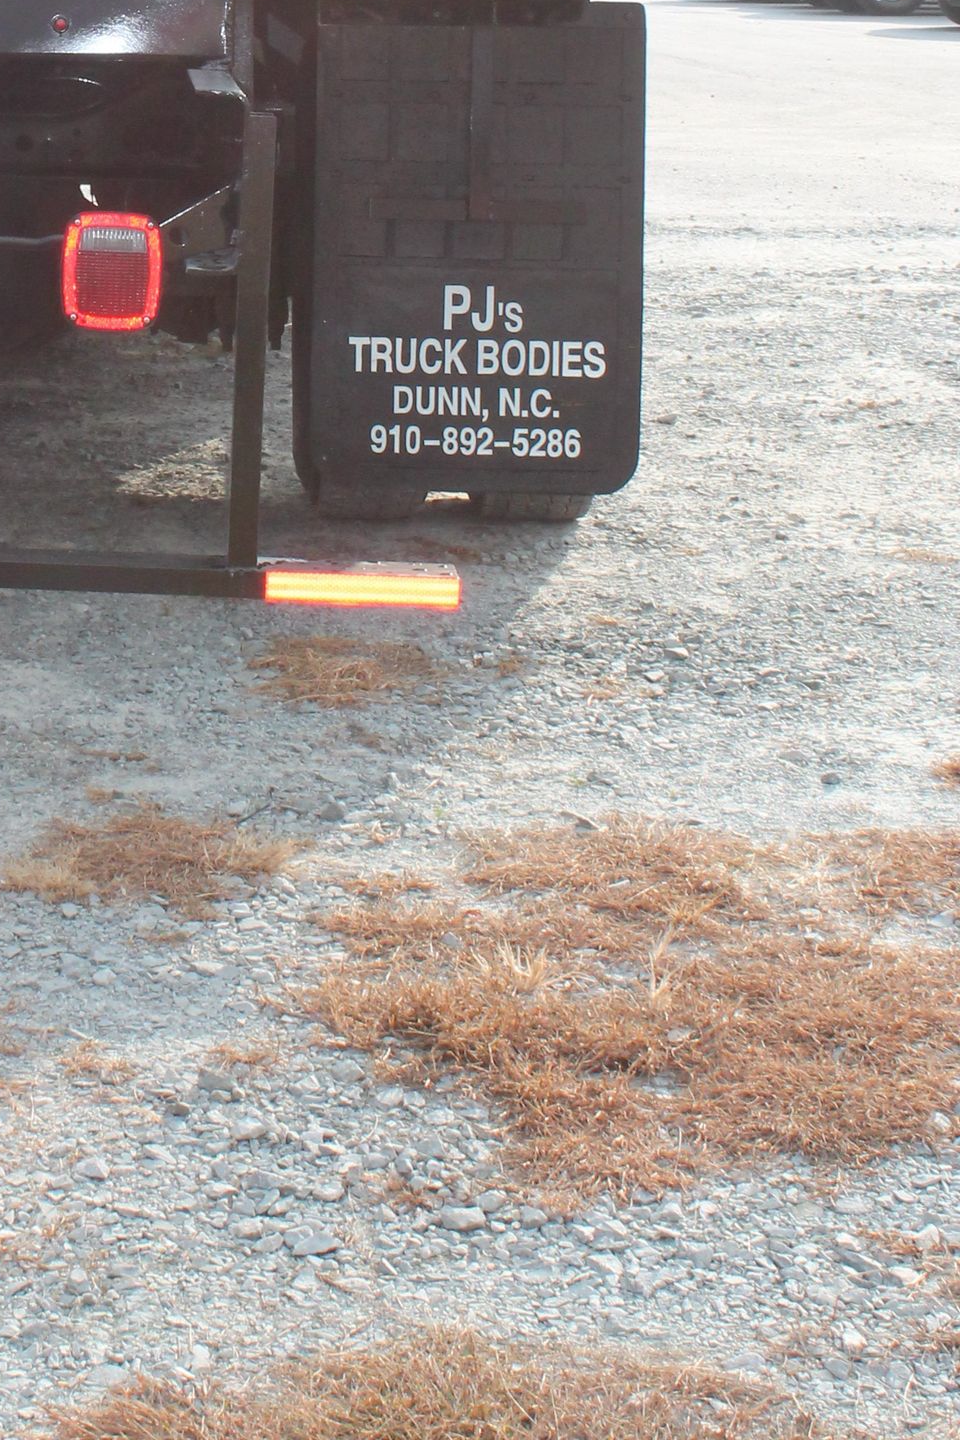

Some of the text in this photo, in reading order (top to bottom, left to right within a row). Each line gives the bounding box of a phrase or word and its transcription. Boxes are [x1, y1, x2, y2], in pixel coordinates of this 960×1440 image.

[443, 284, 523, 333] PJ's
[348, 336, 606, 378] TRUCK BODIES
[393, 385, 560, 422] DUNN, N.C.
[370, 424, 582, 458] 910-892-5286
